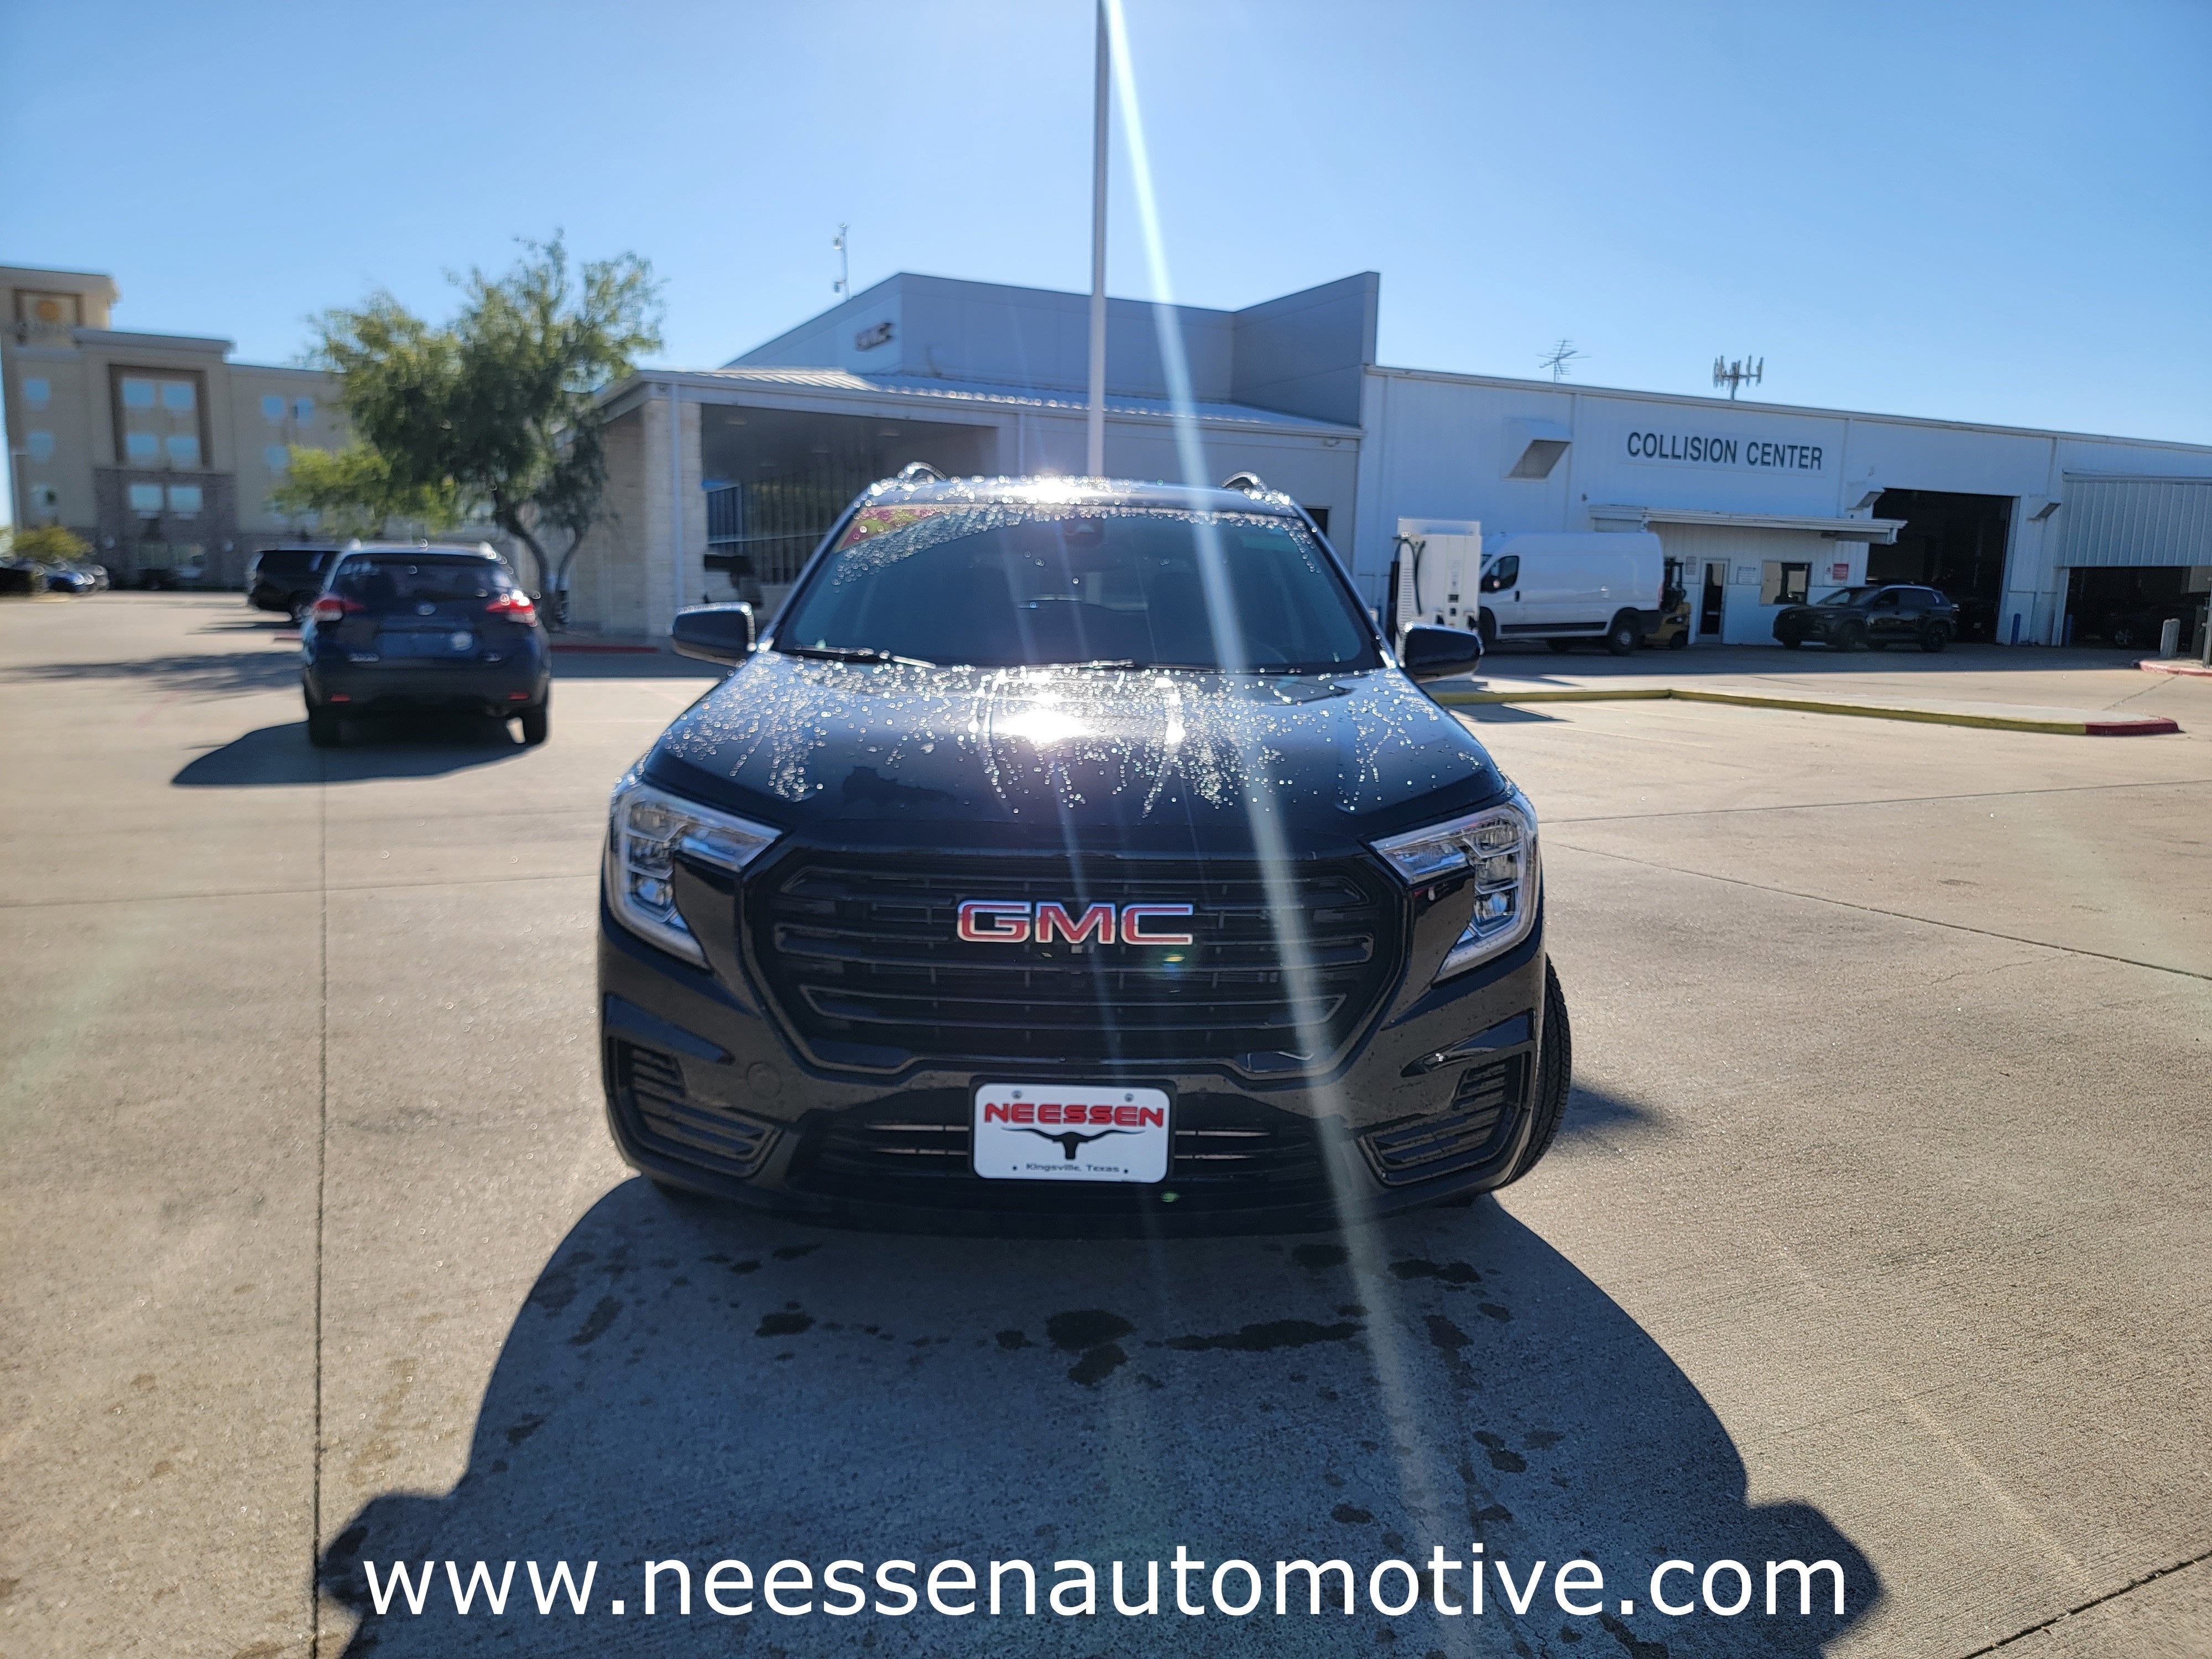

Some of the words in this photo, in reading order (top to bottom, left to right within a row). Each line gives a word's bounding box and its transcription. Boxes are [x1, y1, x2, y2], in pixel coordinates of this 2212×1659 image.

[1627, 432, 1738, 464] COLLISION
[1746, 442, 1823, 471] CENTER
[957, 900, 1193, 945] GMC
[984, 1103, 1164, 1128] NEESSEN
[1086, 1164, 1120, 1172] Texas
